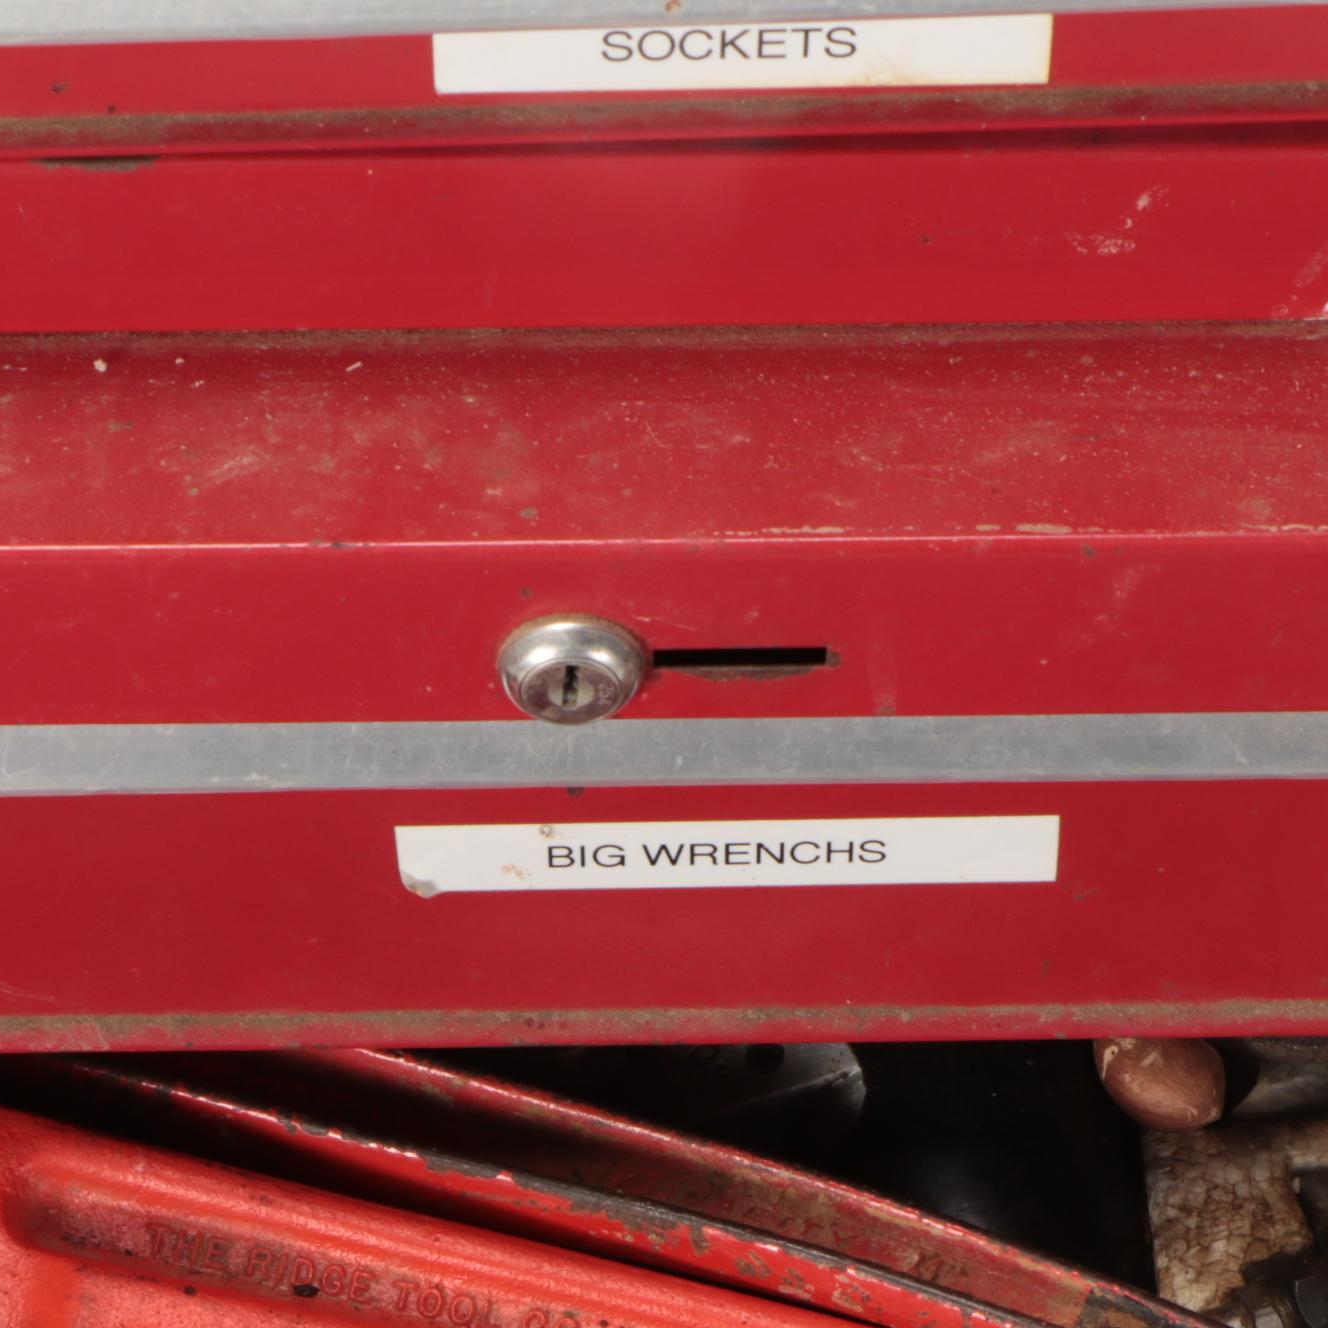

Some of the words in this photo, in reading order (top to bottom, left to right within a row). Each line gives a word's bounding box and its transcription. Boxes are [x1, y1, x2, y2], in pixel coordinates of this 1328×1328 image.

[601, 27, 857, 61] SOCKETS
[547, 845, 626, 868] BIG
[642, 840, 887, 866] WRENCHS
[145, 1222, 232, 1271] THE
[245, 1249, 378, 1303] RIDGE
